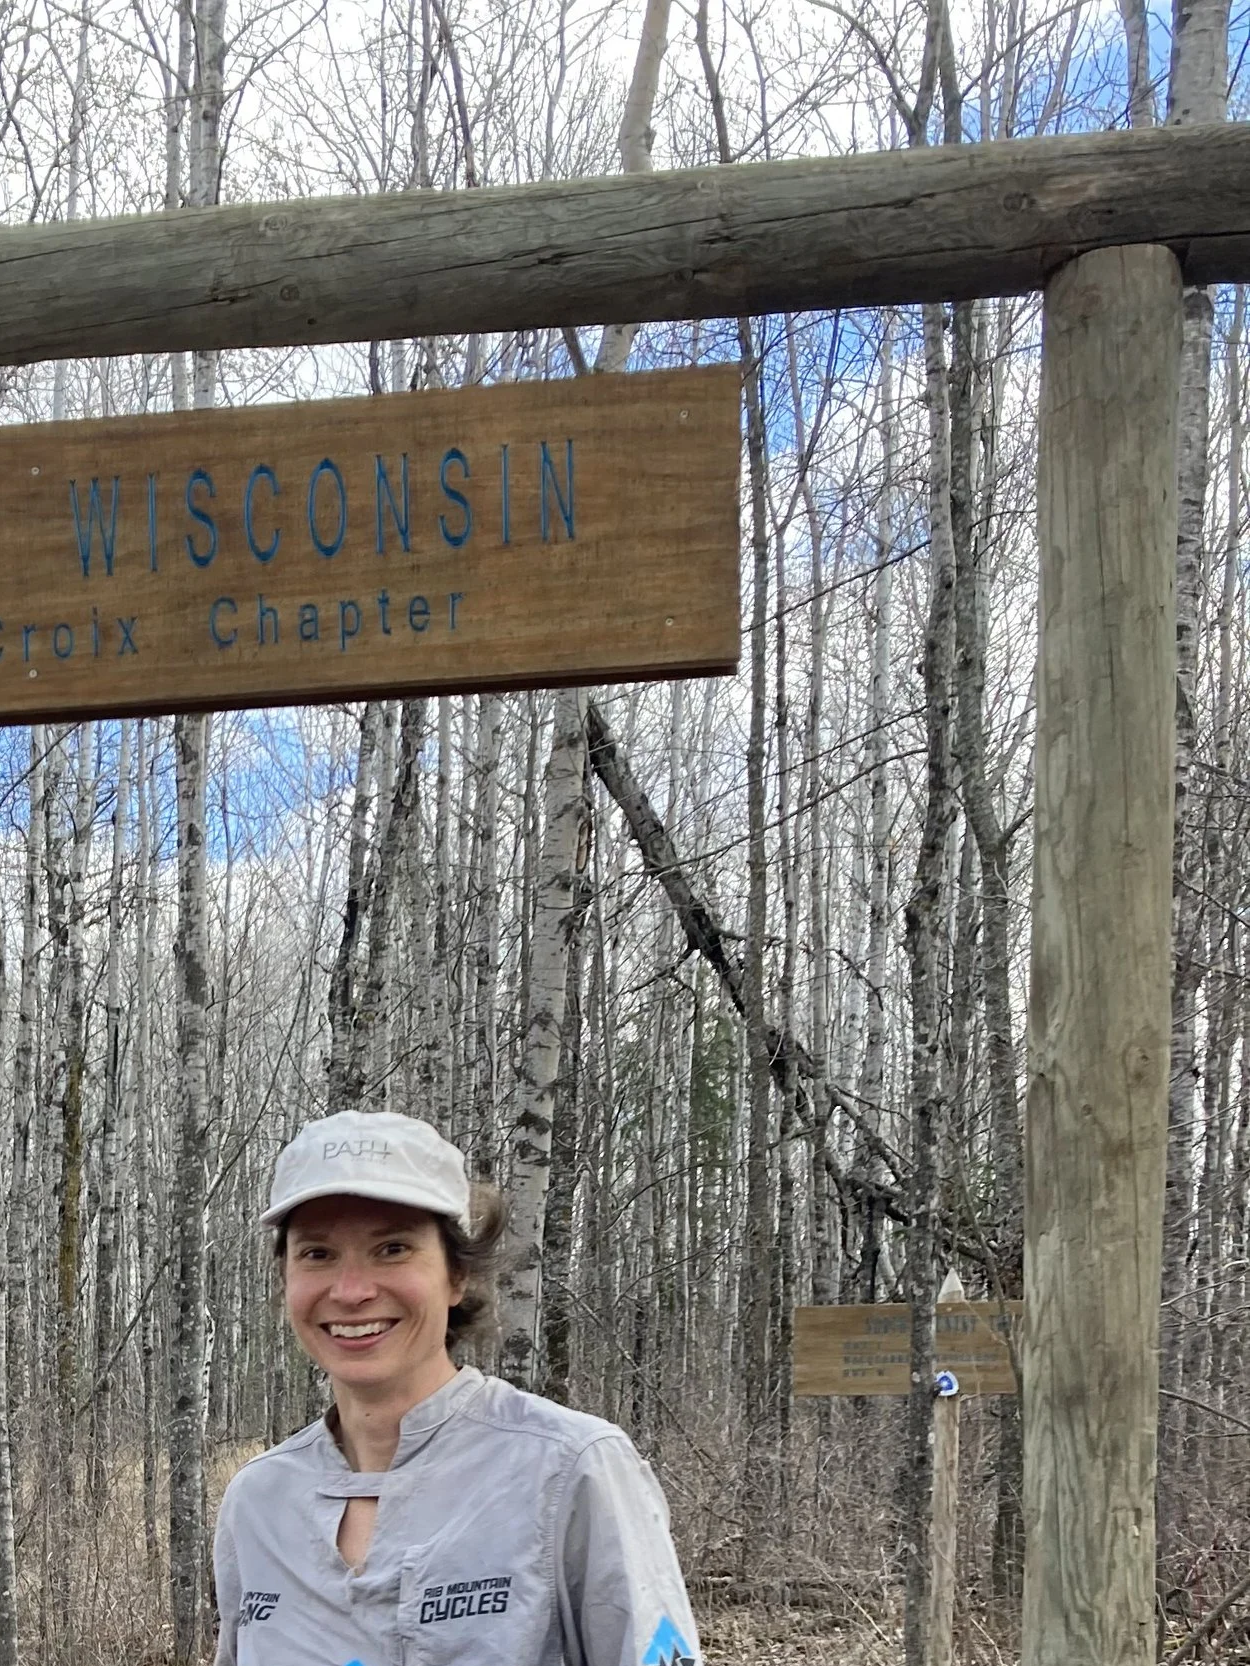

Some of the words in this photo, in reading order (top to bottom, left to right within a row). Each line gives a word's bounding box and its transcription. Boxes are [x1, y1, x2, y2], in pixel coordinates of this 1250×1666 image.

[69, 437, 577, 578] WISCONSIN
[208, 589, 466, 652] Chapter
[419, 1590, 509, 1625] CYCLES
[423, 1585, 444, 1600] RIB
[446, 1576, 512, 1596] MOUNTAIN
